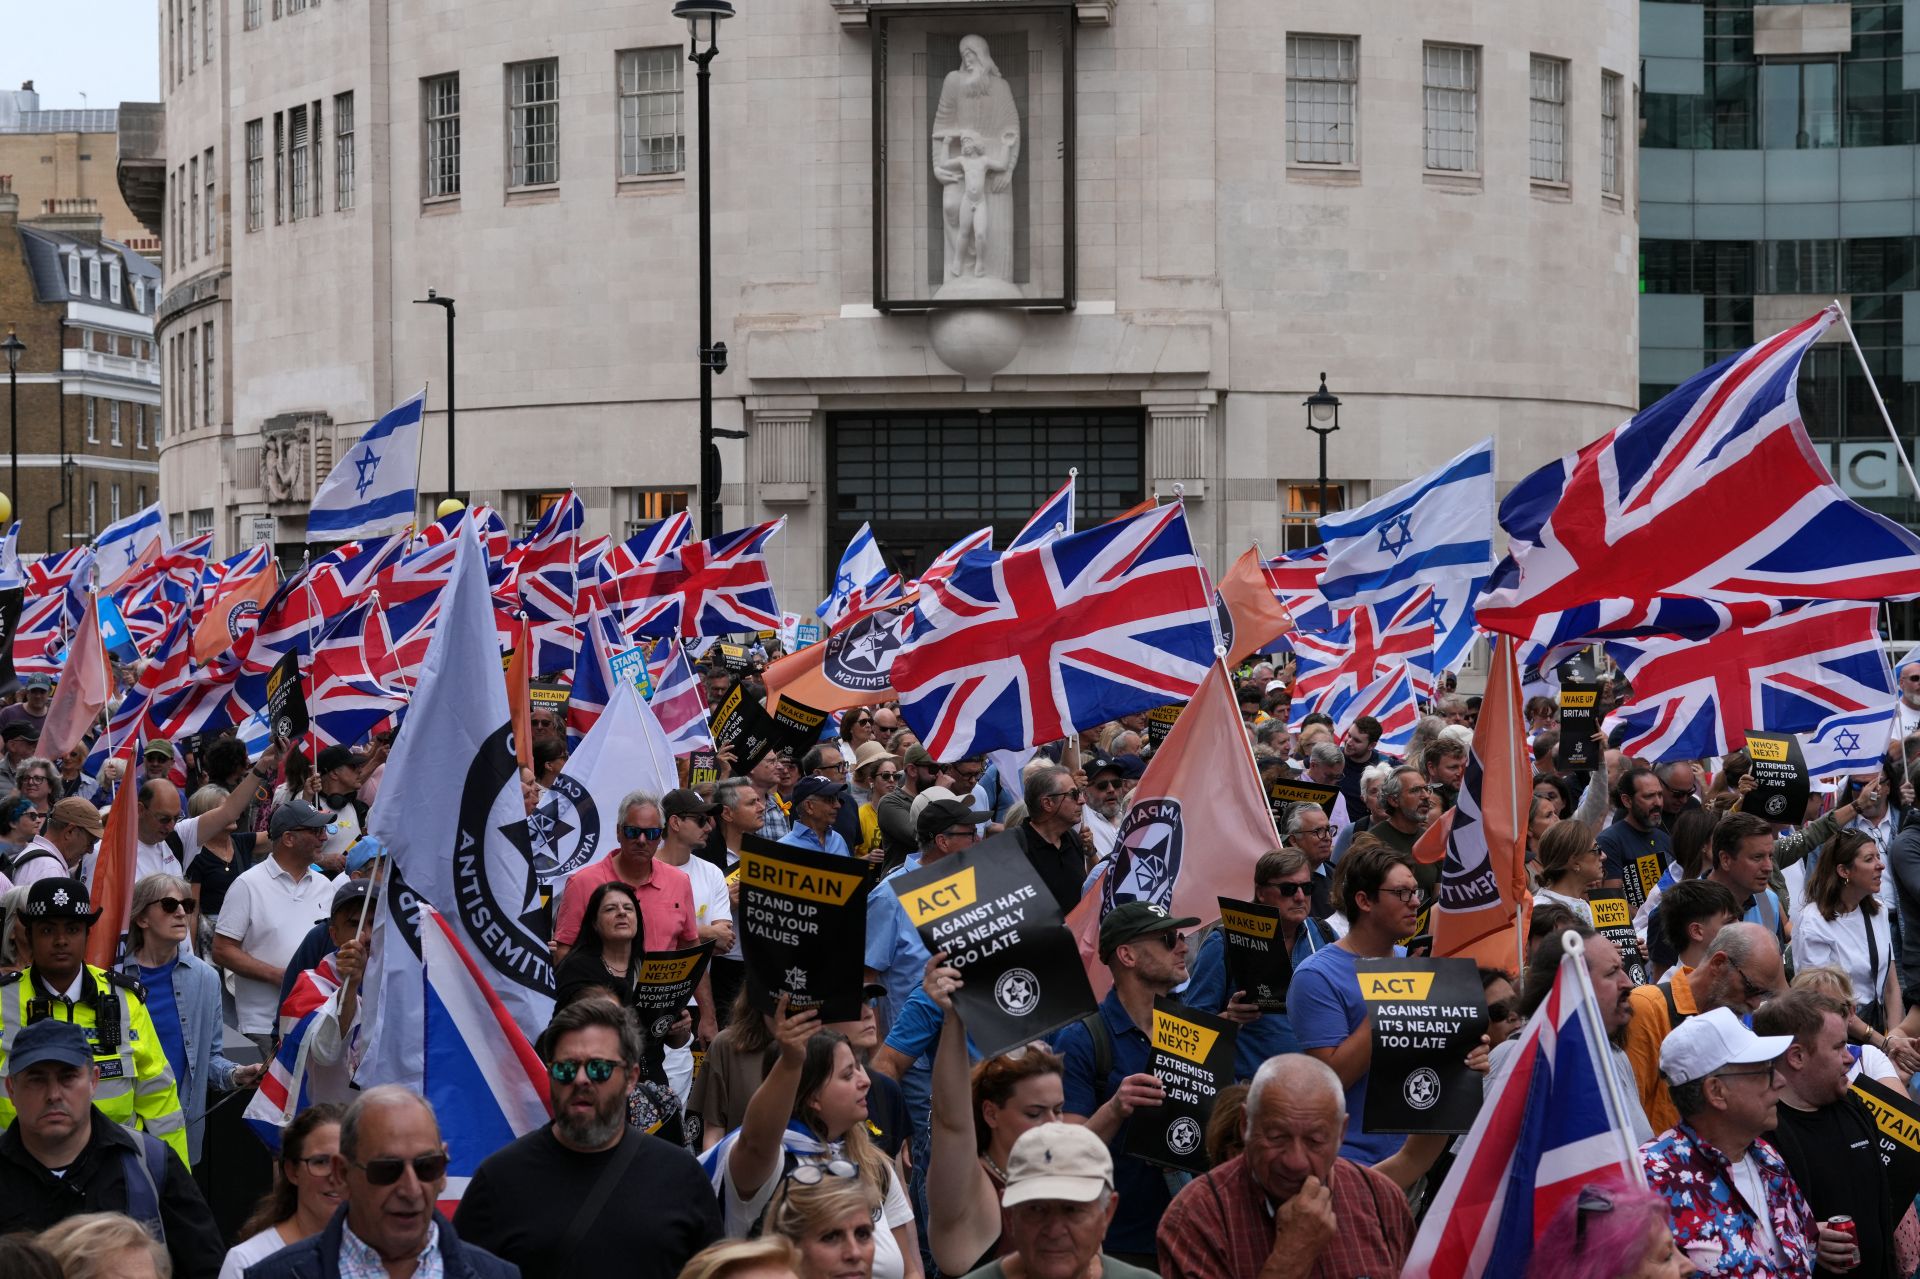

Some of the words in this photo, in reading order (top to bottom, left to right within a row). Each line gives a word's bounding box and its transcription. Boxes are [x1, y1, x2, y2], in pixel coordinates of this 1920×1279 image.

[257, 531, 271, 539] ZONE
[612, 650, 641, 671] STAND
[532, 691, 565, 700] BRITAIN
[1563, 695, 1584, 704] WAKE
[1585, 695, 1594, 703] UP
[713, 694, 739, 733] BRITAIN
[781, 703, 804, 719] WAKE
[805, 715, 818, 724] UP
[1563, 709, 1590, 718] BRITAIN
[728, 715, 744, 734] YOUR
[776, 714, 809, 733] BRITAIN
[1751, 740, 1780, 750] WHO'S
[1754, 749, 1780, 758] NEXT?
[1756, 761, 1795, 771] EXTREMISTS
[1756, 770, 1779, 778] WON'T
[1766, 779, 1786, 787] JEWS
[1278, 788, 1311, 799] WAKE
[1312, 793, 1327, 801] UP
[747, 860, 842, 898] BRITAIN
[747, 890, 794, 913] STAND
[798, 904, 818, 918] UP
[917, 883, 961, 916] ACT
[1595, 902, 1625, 912] WHO'S
[458, 828, 556, 990] ANTISEMITIS
[932, 902, 995, 941] AGAINST
[995, 885, 1037, 911] HATE
[746, 906, 774, 924] FOR
[778, 915, 819, 935] YOUR
[967, 908, 1025, 943] NEARLY
[1225, 914, 1255, 930] WAKE
[1257, 922, 1272, 933] UP
[1597, 912, 1625, 923] NEXT?
[746, 921, 800, 946] VALUES
[981, 930, 1021, 957] LATE
[1229, 933, 1269, 952] BRITAIN
[648, 961, 688, 972] WHO'S
[644, 970, 682, 980] NEXT?
[639, 993, 671, 1001] WON'T
[671, 987, 691, 999] STOP
[640, 980, 692, 993] EXTREMISTS
[1372, 978, 1416, 994] ACT
[635, 1001, 650, 1009] AT
[651, 1000, 675, 1009] JEWS
[1377, 1005, 1438, 1017] AGAINST
[1441, 1006, 1479, 1018] HATE
[1158, 1016, 1200, 1043] WHO'S
[1379, 1020, 1404, 1032] IT'S
[1407, 1021, 1461, 1034] NEARLY
[1158, 1031, 1197, 1056] NEXT?
[1380, 1035, 1410, 1048] TOO
[1413, 1036, 1447, 1049] LATE
[1155, 1053, 1215, 1083] EXTREMISTS
[1153, 1068, 1190, 1088] WON'T
[1191, 1080, 1217, 1097] STOP
[1168, 1087, 1199, 1105] JEWS
[1879, 1138, 1897, 1152] UP
